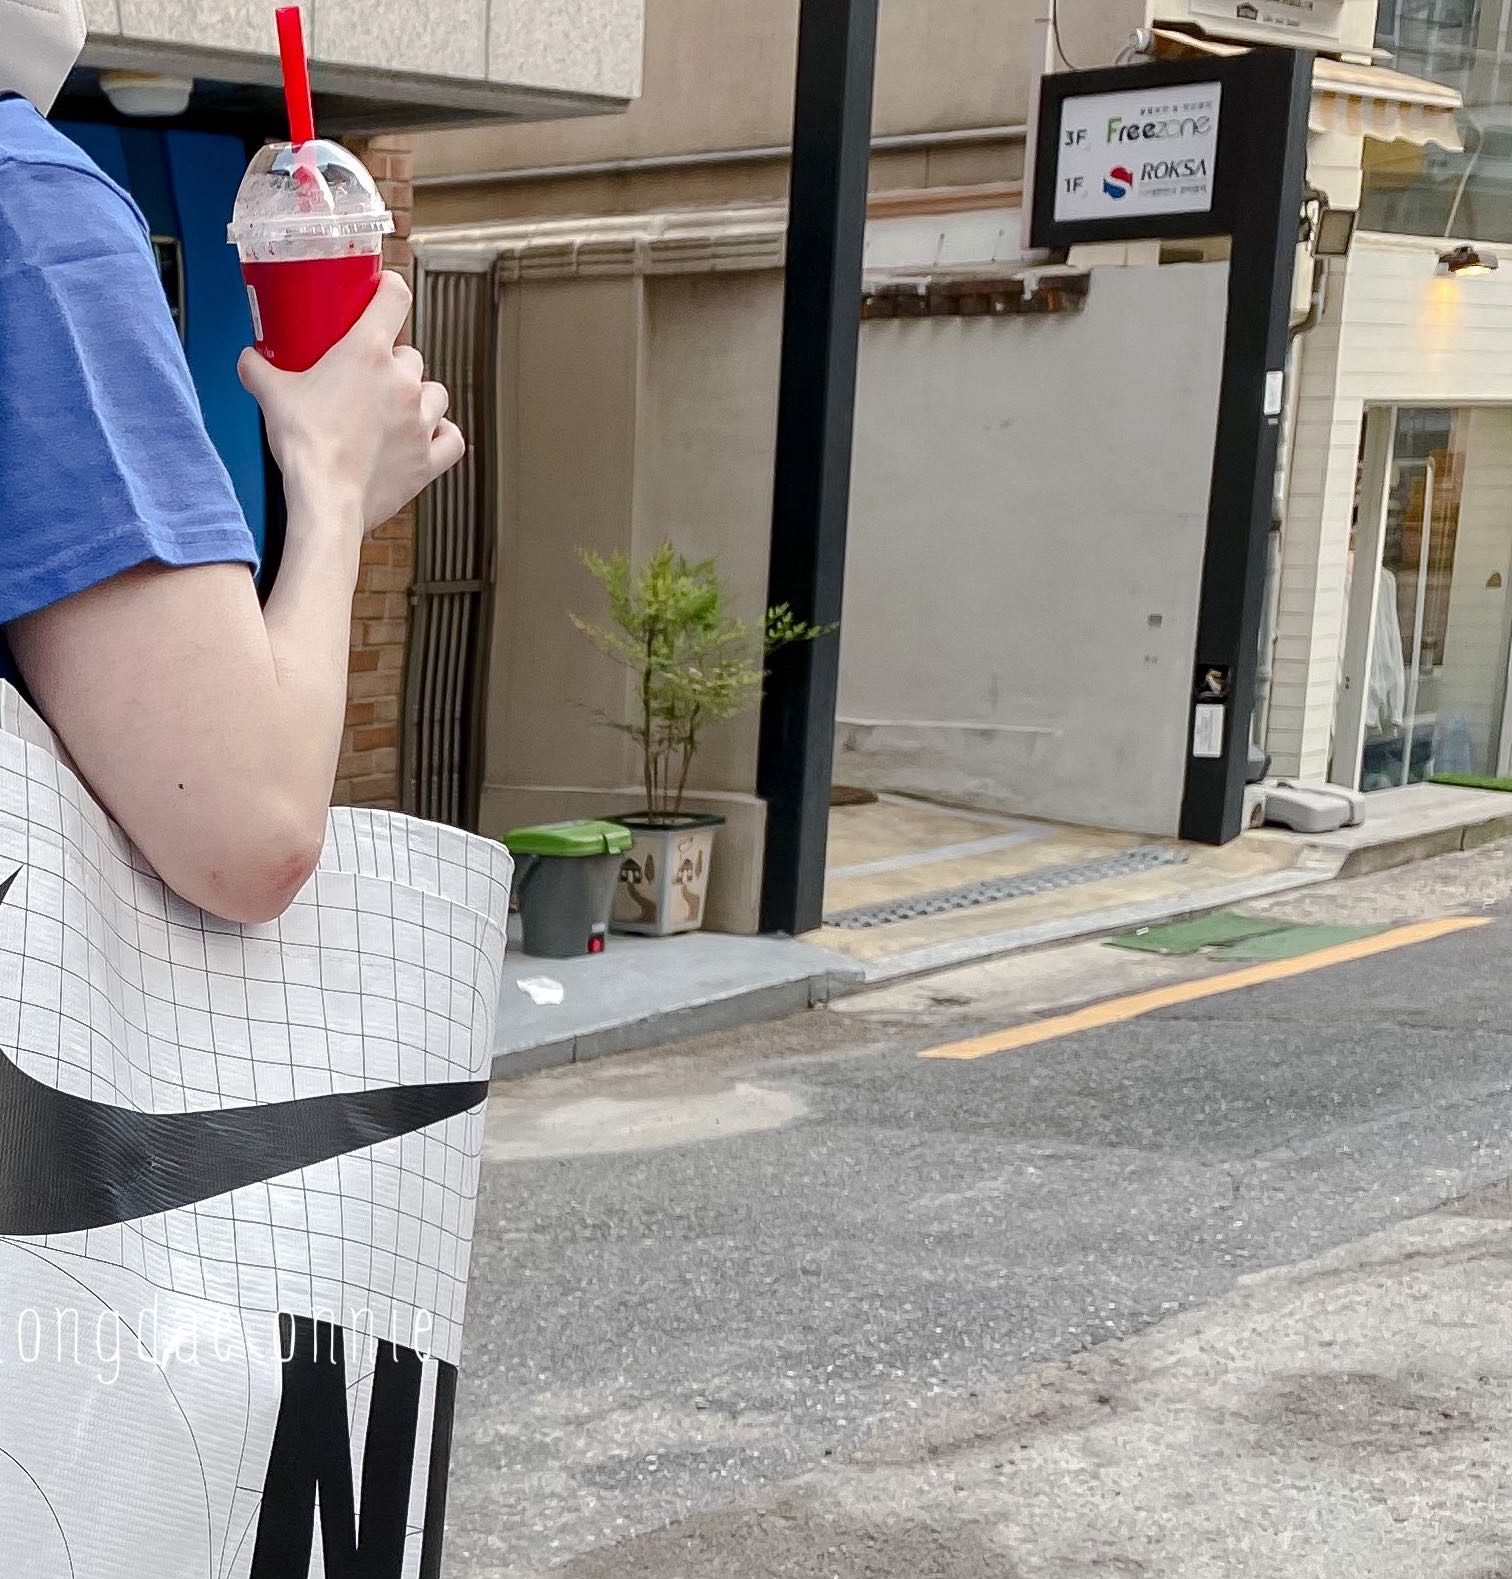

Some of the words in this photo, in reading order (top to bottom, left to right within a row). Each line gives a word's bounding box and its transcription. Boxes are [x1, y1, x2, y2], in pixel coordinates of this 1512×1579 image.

[1064, 128, 1088, 146] 3F
[1105, 115, 1211, 144] Freezone
[1140, 158, 1208, 181] ROKSA
